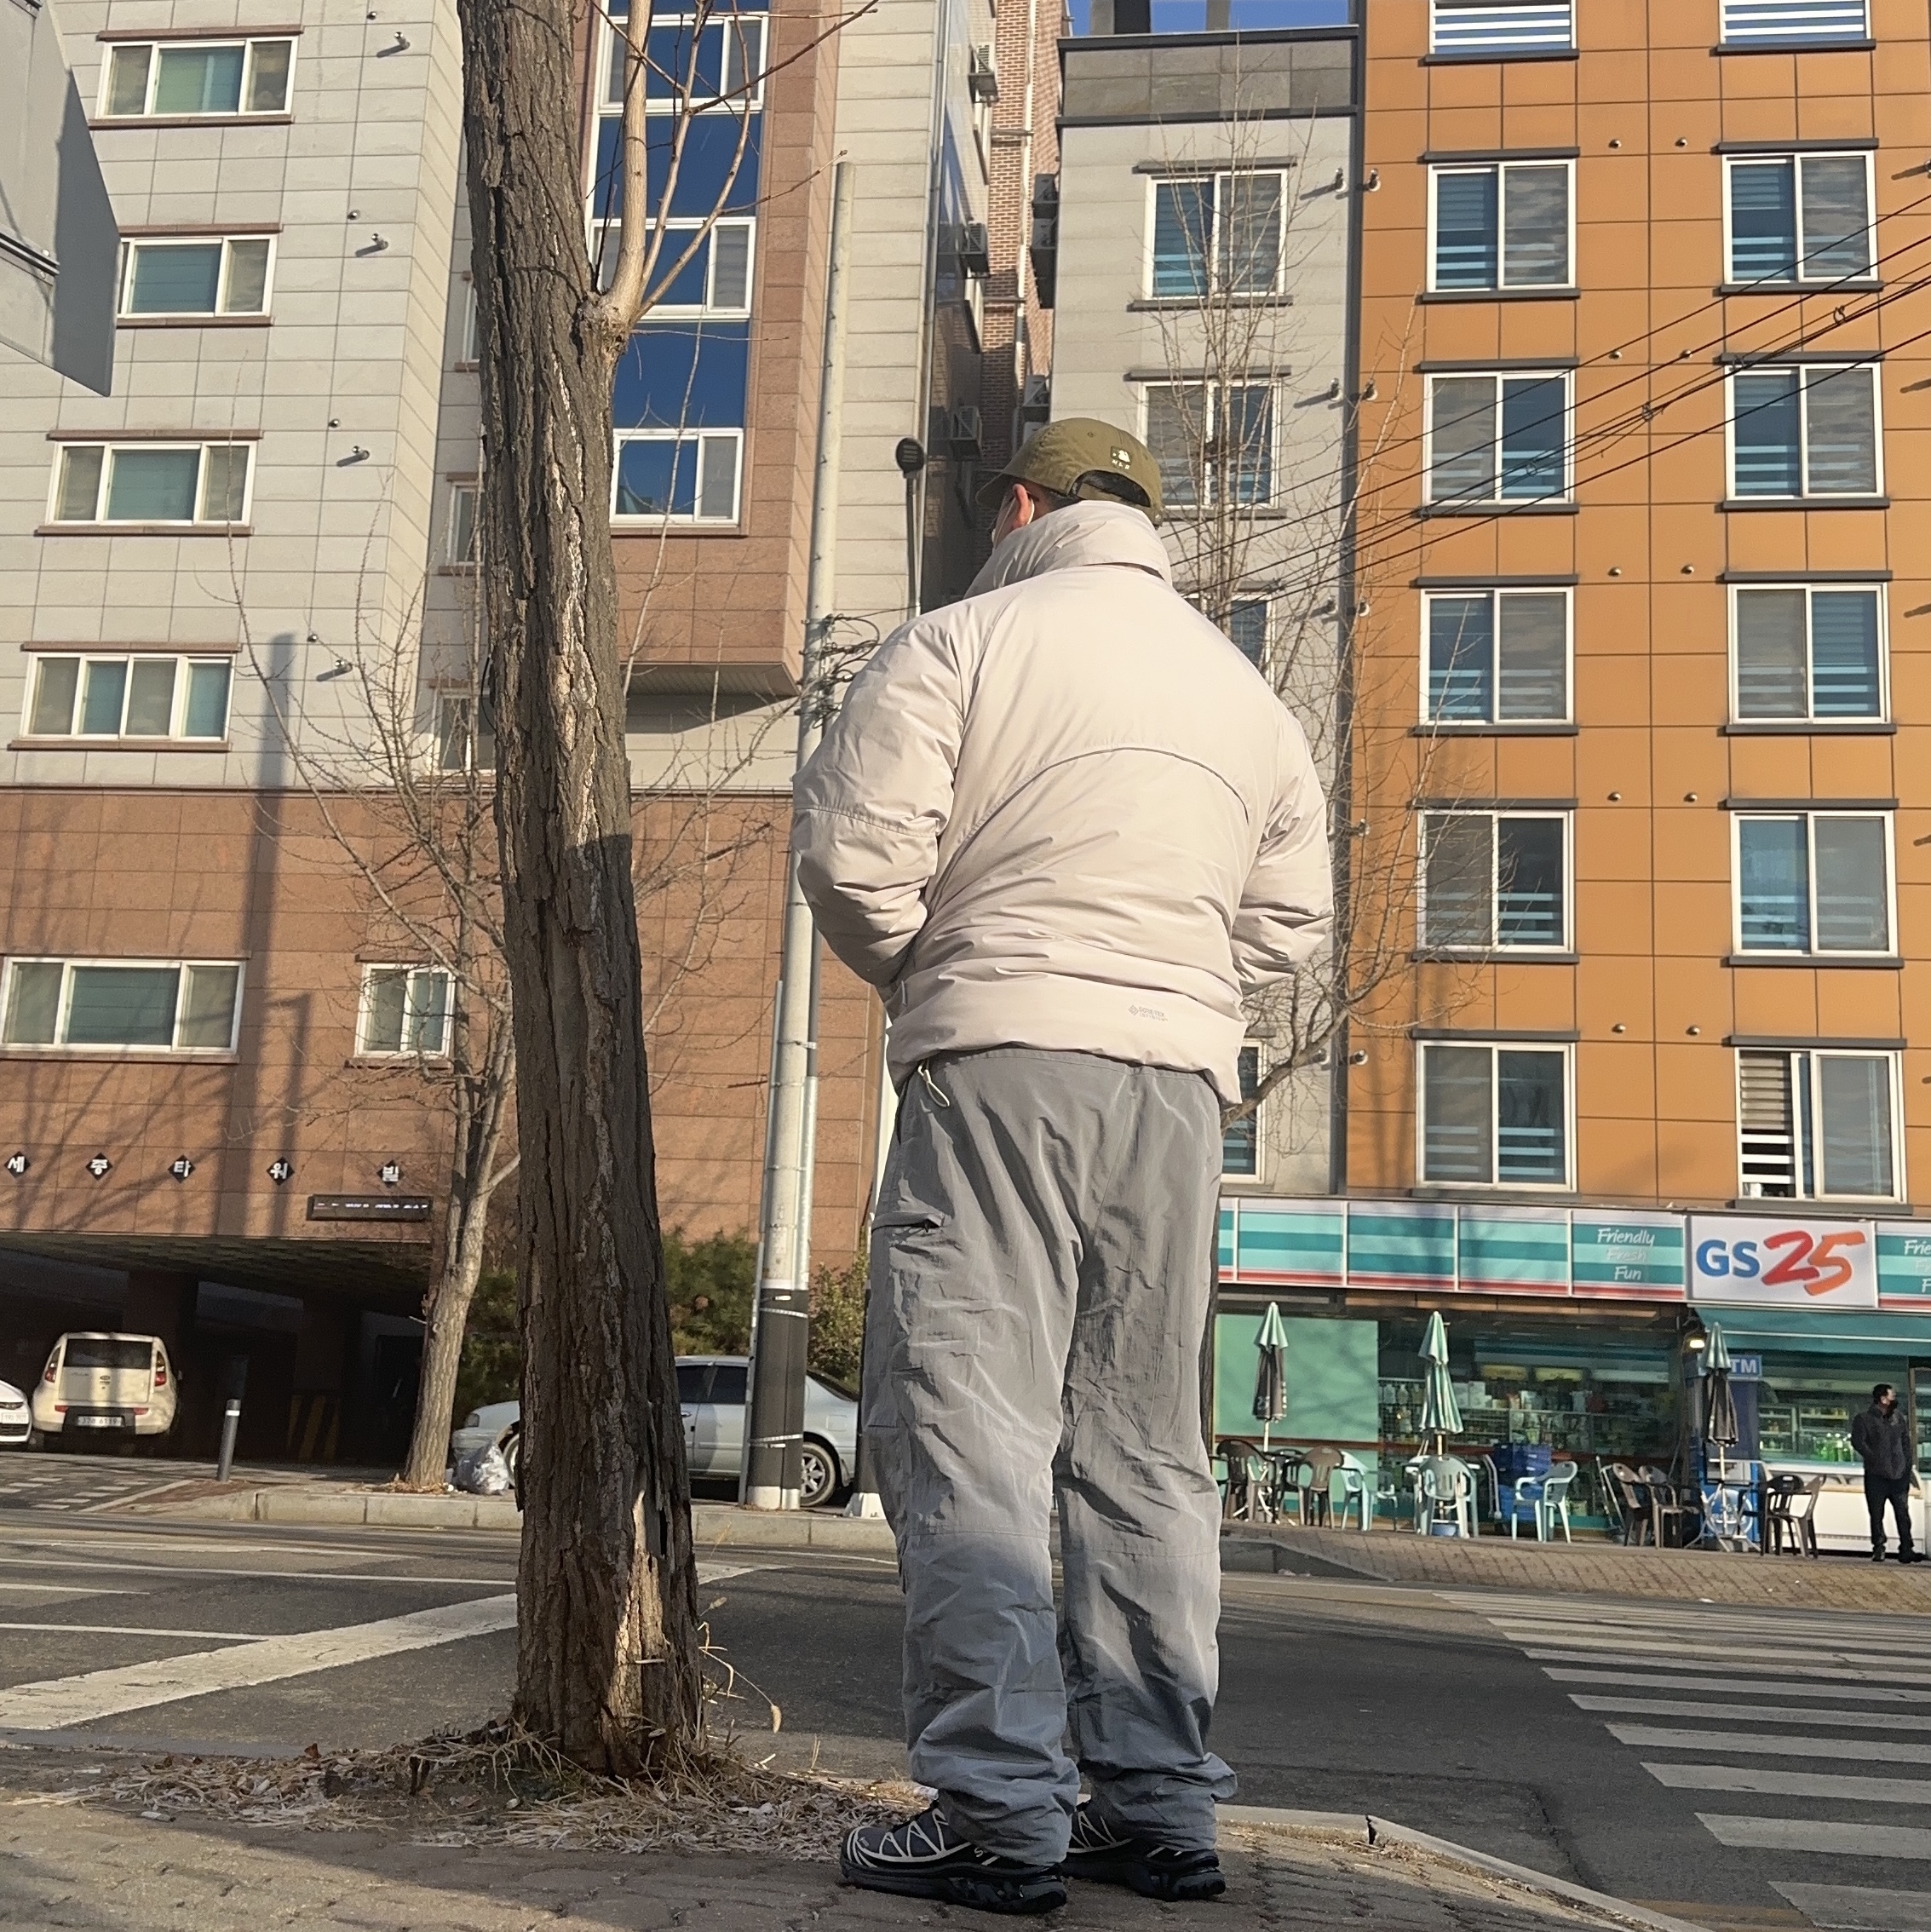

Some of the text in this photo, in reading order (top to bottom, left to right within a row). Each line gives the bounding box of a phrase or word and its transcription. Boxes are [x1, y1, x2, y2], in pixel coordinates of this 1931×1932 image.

[1597, 1228, 1656, 1248] Friendly
[1606, 1246, 1647, 1262] Fresh
[1696, 1230, 1866, 1297] GS25
[1614, 1266, 1642, 1280] Fun
